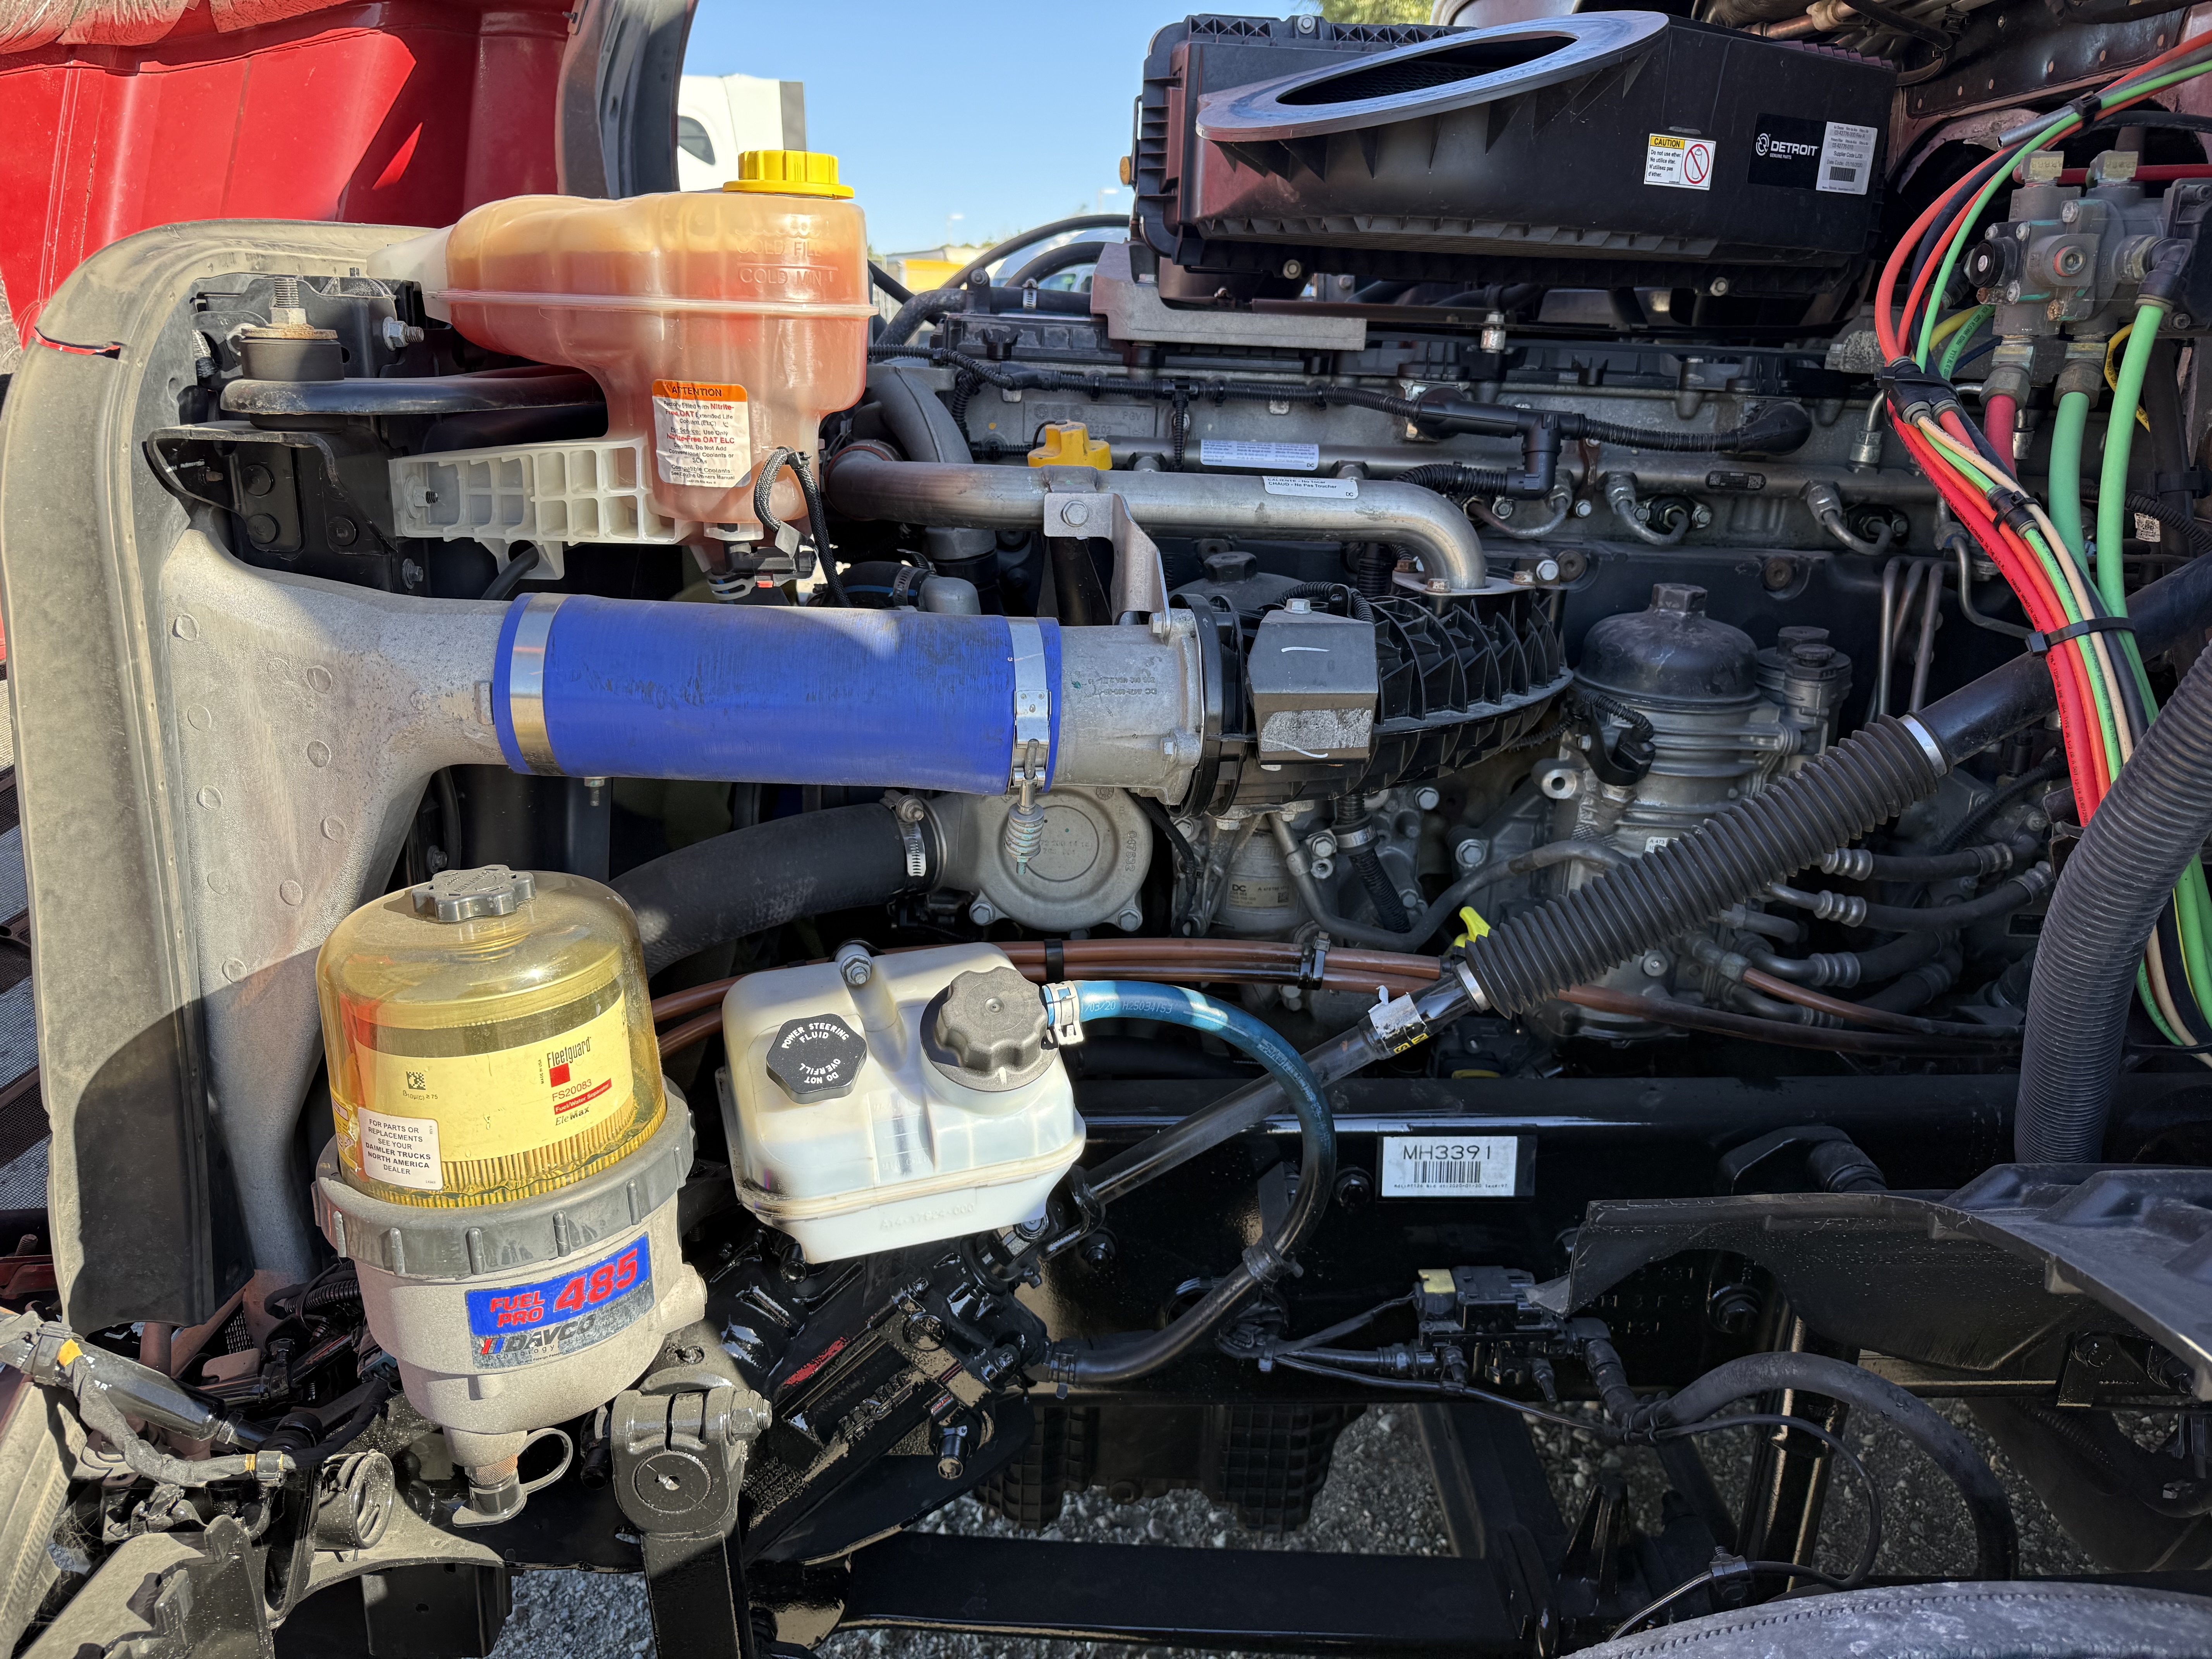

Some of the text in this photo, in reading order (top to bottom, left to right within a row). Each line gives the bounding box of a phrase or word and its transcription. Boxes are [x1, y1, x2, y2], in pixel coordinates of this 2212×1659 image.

[1654, 138, 1680, 148] CAUTION
[1771, 141, 1818, 156] DETROIT
[739, 268, 788, 284] COLD
[672, 386, 722, 397] ATTENTION
[667, 433, 701, 443] Nitrite-Free
[672, 464, 702, 472] Compatible
[1125, 831, 1137, 871] 047532
[1232, 884, 1246, 892] DC
[781, 1022, 849, 1049] POWER STEERING
[799, 1031, 829, 1043] FLUID
[547, 1037, 591, 1068] Fleetguard
[799, 1058, 841, 1075] OVERFILL
[826, 1072, 839, 1082] DO
[552, 1079, 592, 1102] FS20083
[555, 1083, 610, 1113] Fuel/Water Separator
[555, 1107, 590, 1126] EleMax
[369, 1119, 382, 1128] FOR
[383, 1123, 406, 1132] PARTS
[368, 1127, 423, 1142] REPLACEMENTS
[366, 1142, 431, 1160] DAIMLER TRUCKS
[378, 1138, 412, 1150] SEE YOUR
[1403, 1144, 1491, 1160] MH3391
[368, 1151, 429, 1168] NORTH AMERICA
[383, 1164, 410, 1175] DEALER
[554, 1247, 638, 1313] 485
[490, 1290, 545, 1312] FUEL
[497, 1306, 544, 1328] PRO
[505, 1313, 596, 1352] DAVCO
